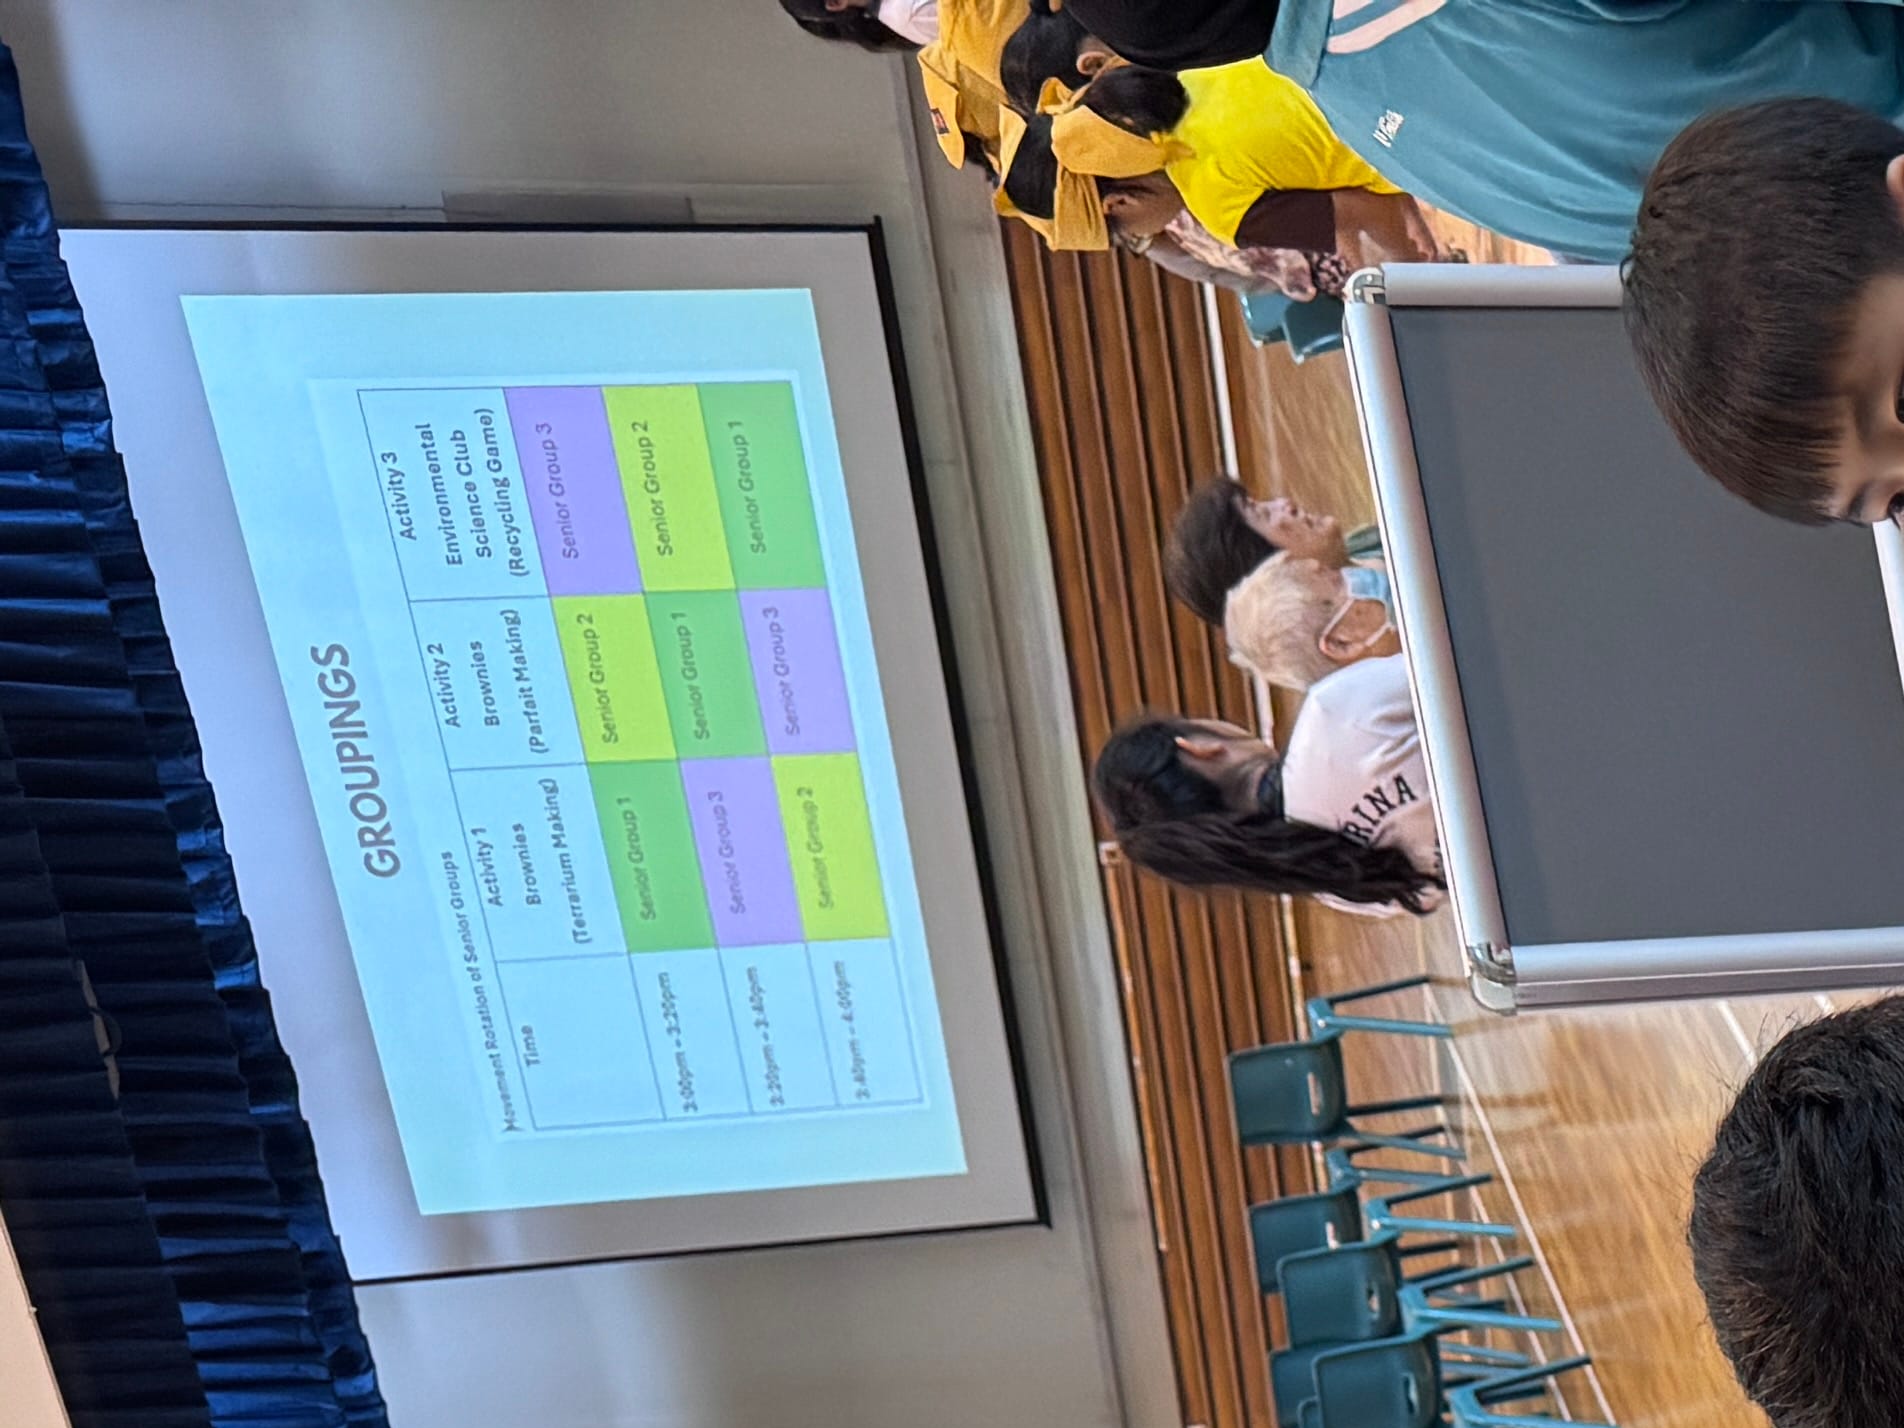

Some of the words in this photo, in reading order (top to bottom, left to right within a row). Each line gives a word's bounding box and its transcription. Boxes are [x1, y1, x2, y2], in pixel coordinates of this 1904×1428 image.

[474, 408, 504, 473] Game)
[536, 422, 553, 435] 3
[631, 420, 648, 432] 2
[727, 420, 743, 428] 1
[381, 451, 398, 464] 3
[450, 430, 475, 477] Club
[541, 439, 567, 497] Group
[637, 436, 662, 494] Group
[729, 435, 756, 492] Group
[385, 468, 417, 541] Activity
[415, 423, 463, 565] Environmental
[463, 481, 494, 558] Science
[489, 477, 530, 577] (Recycling
[554, 501, 580, 560] Senior
[648, 499, 674, 557] Senior
[742, 497, 767, 554] Senior
[577, 613, 593, 625] 2
[671, 612, 685, 620] 1
[763, 606, 780, 619] 3
[427, 643, 443, 655] 2
[499, 609, 532, 682] Making)
[580, 628, 606, 684] Group
[673, 626, 699, 681] Group
[764, 620, 791, 677] Group
[432, 657, 461, 728] Activity
[468, 640, 500, 727] Brownies
[776, 680, 801, 736] Senior
[518, 686, 550, 754] (Parfait
[593, 688, 620, 744] Senior
[685, 685, 710, 740] Senior
[310, 641, 403, 879] GROUPINGS
[539, 778, 569, 848] Making)
[617, 796, 631, 805] 1
[708, 791, 724, 802] 3
[797, 787, 814, 800] 2
[471, 827, 487, 837] 1
[619, 809, 646, 863] Group
[711, 804, 736, 858] Group
[800, 800, 826, 854] Group
[440, 851, 466, 909] Groups
[475, 841, 504, 907] Activity
[510, 823, 541, 905] Brownies
[724, 861, 747, 914] Senior
[812, 857, 835, 909] Senior
[557, 852, 593, 944] (Terrarium
[631, 867, 657, 921] Senior
[456, 912, 479, 963] Senior
[467, 966, 481, 981] of
[471, 985, 499, 1050] Rotation
[519, 1025, 541, 1066] Time
[488, 1053, 518, 1130] Movement
